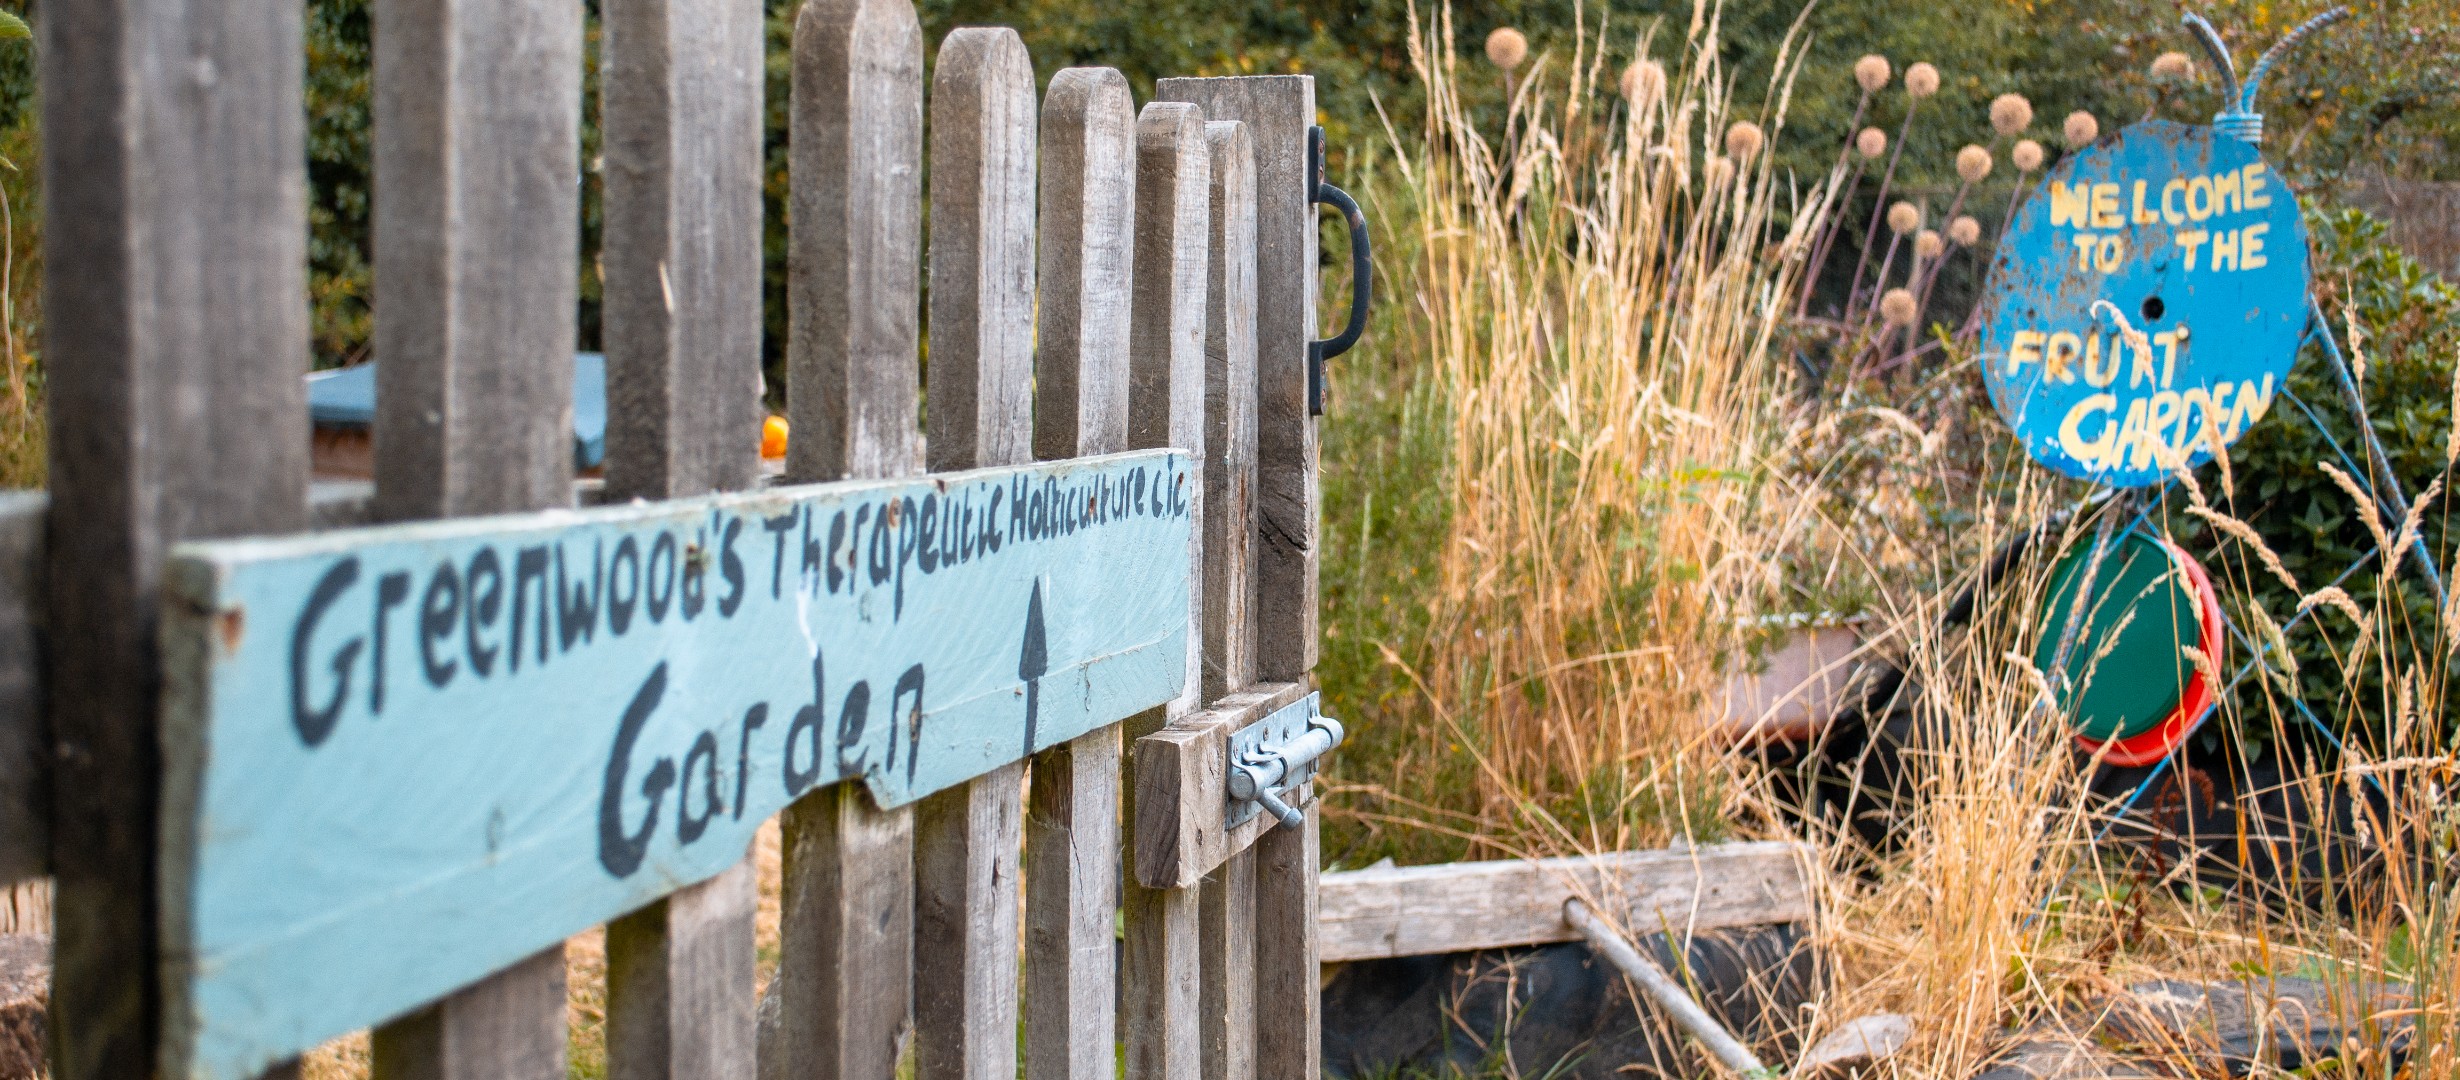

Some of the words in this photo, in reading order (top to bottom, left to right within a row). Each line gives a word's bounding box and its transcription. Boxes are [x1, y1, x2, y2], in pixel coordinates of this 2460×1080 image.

[2050, 162, 2272, 229] WELCOME
[2073, 233, 2125, 274] TO
[2175, 222, 2270, 272] THE
[2058, 371, 2275, 472] GARDEN
[289, 509, 745, 749] Greenwood's
[763, 482, 1004, 624] Therapeutic
[1009, 465, 1146, 545] Horticulture
[597, 645, 925, 881] Garden
